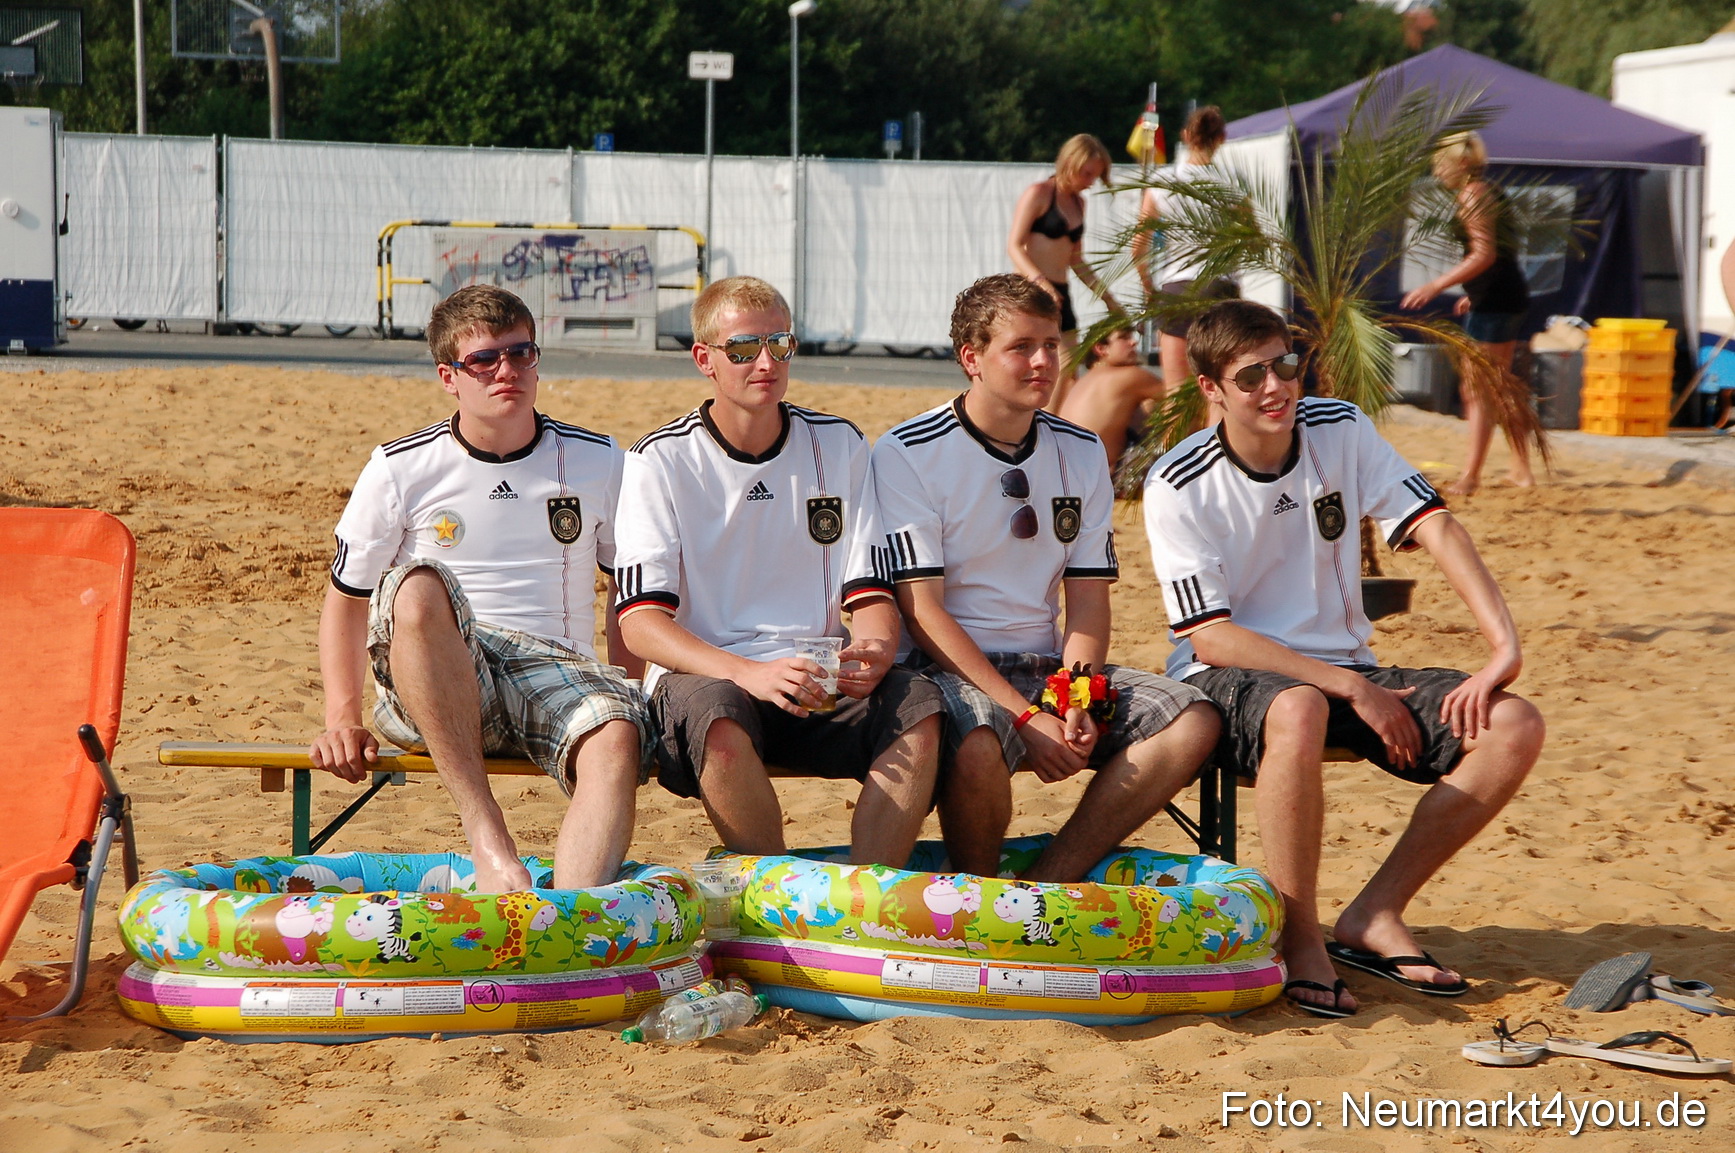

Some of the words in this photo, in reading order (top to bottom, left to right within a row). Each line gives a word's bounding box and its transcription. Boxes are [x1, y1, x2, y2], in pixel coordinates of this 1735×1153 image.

[713, 60, 729, 69] WC
[600, 135, 610, 150] P
[488, 492, 519, 500] adidas
[746, 492, 774, 501] adidas
[1273, 501, 1299, 515] adidas
